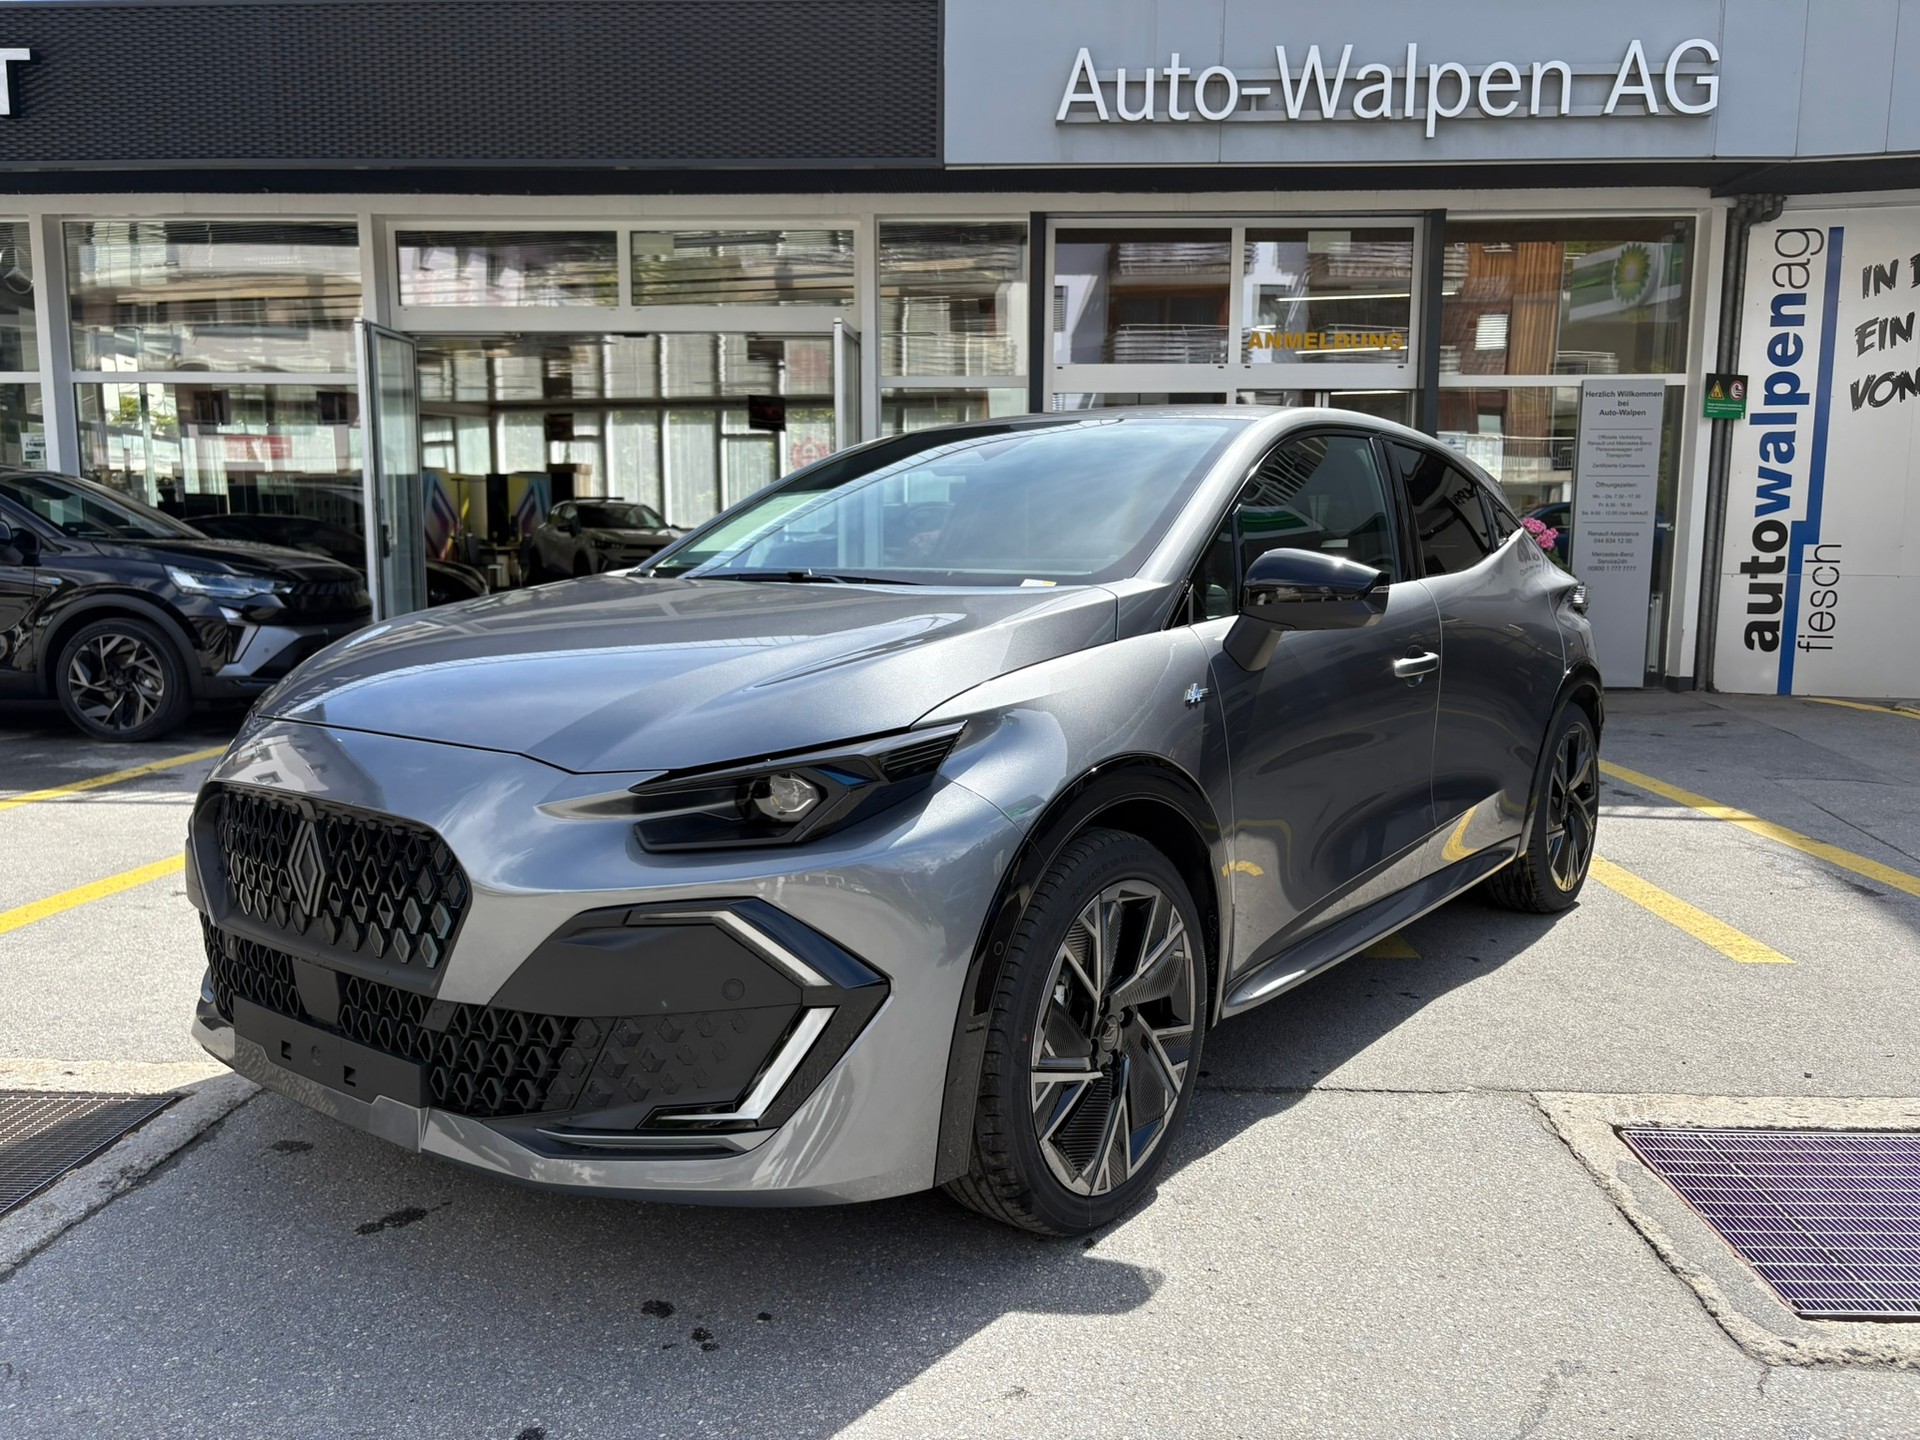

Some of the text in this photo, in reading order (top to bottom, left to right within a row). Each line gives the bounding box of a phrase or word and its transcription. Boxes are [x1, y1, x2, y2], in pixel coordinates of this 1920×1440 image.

[1056, 38, 1721, 138] Auto-Walpen AG
[1862, 258, 1899, 299] IN
[1248, 331, 1404, 350] ANMELDUNG
[1854, 311, 1916, 358] EIN
[1585, 390, 1662, 398] Herzlich Willkommen
[1599, 409, 1646, 417] Auto-Walpen
[1797, 544, 1842, 653] fiesch
